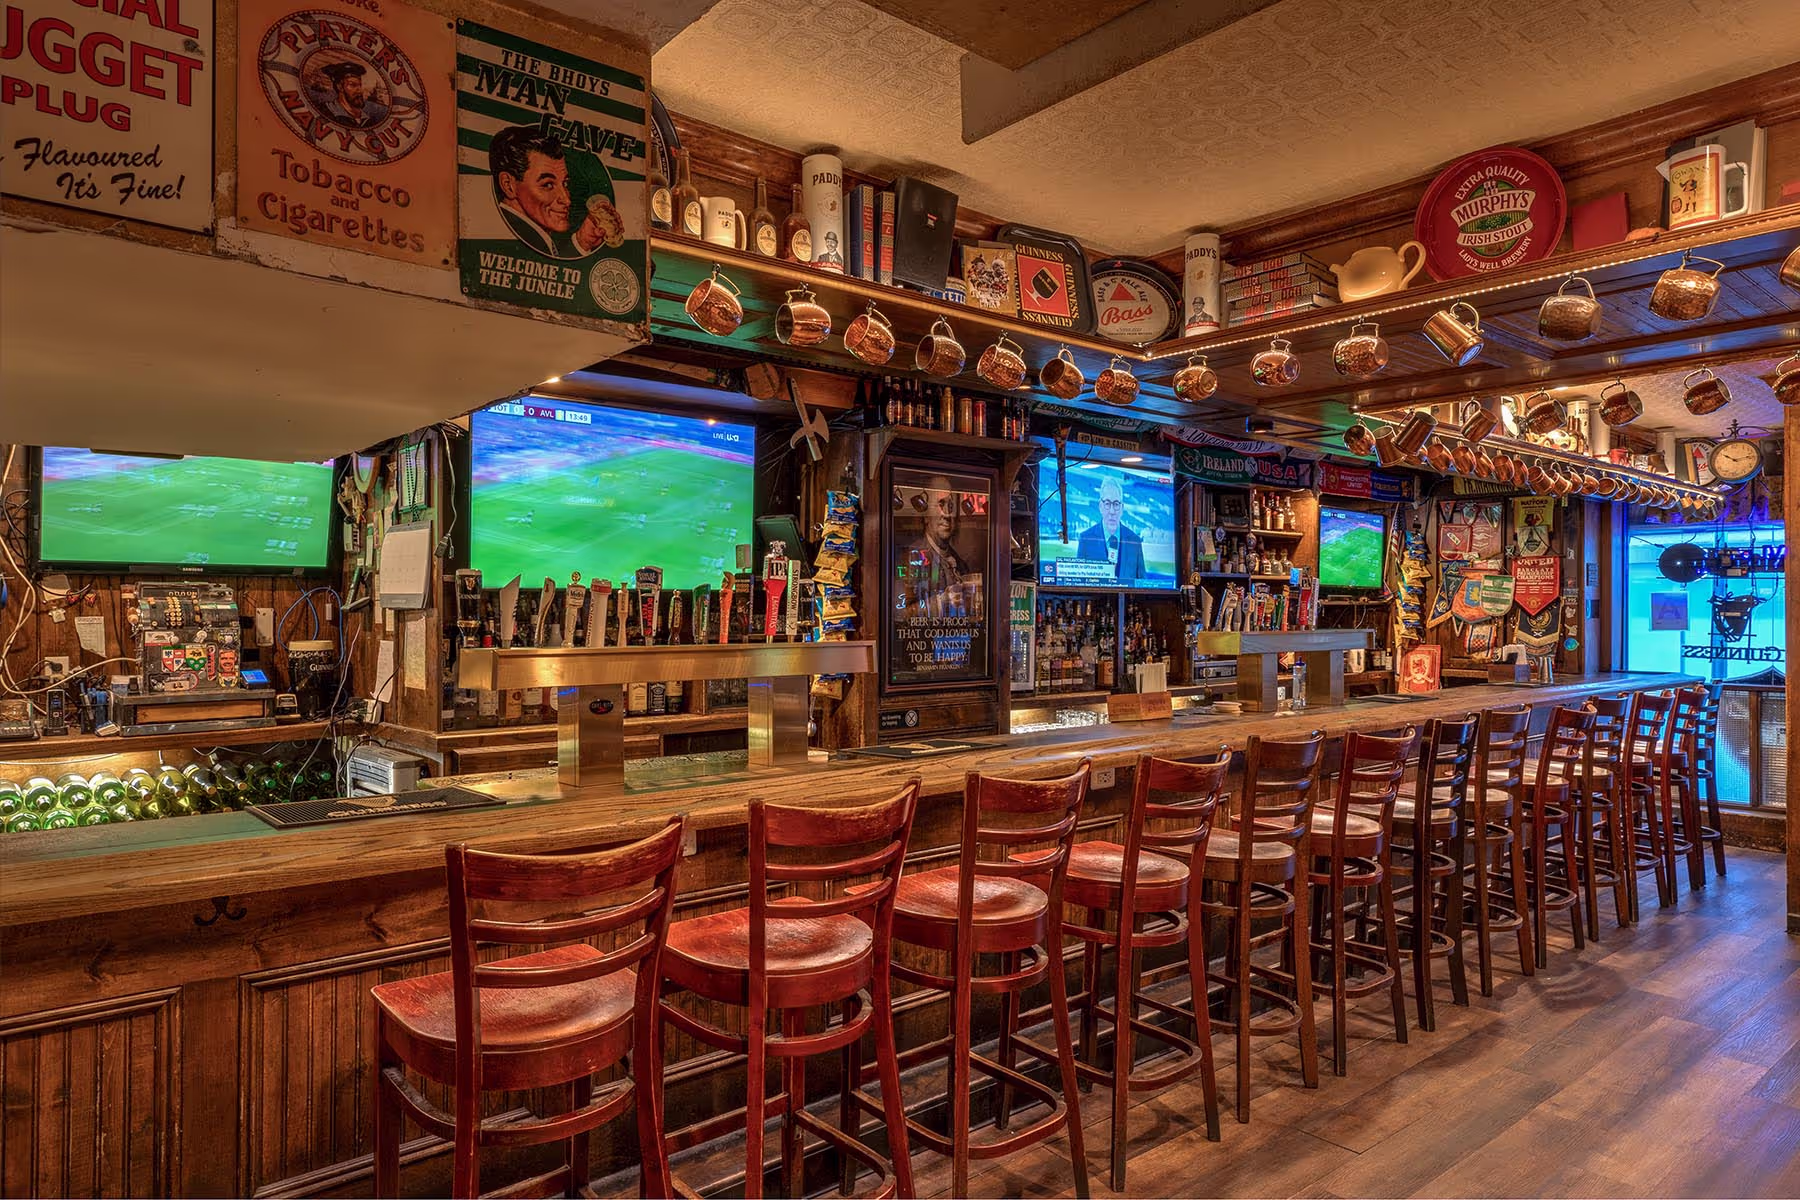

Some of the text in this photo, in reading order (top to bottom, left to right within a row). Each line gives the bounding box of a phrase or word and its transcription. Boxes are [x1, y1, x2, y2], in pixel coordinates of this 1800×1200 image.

[278, 19, 411, 85] PLAYER'S
[474, 62, 571, 115] MAN
[502, 49, 610, 96] THE BHOYS
[1, 75, 131, 132] PLUG
[279, 90, 413, 154] NAVY CUT
[540, 113, 636, 161] CAVE
[14, 137, 164, 171] Flavoured
[56, 172, 186, 206] It's Fine!
[271, 148, 411, 208] Tobacco
[1454, 165, 1530, 200] EXTRA QUALITY
[330, 195, 360, 211] and
[1455, 190, 1530, 223] MURPHY'S
[257, 191, 425, 252] Cigarettes
[1462, 221, 1528, 245] IRISH STOUT
[479, 251, 581, 285] WELCOME TO
[1015, 243, 1064, 262] GUINNESS
[1458, 249, 1478, 267] LADY'S
[1479, 261, 1500, 270] WELL
[1502, 235, 1532, 266] BREWERY
[479, 268, 513, 288] THE
[516, 276, 576, 300] JUNGLE
[1064, 263, 1079, 319] GUINNESS
[1120, 277, 1141, 290] PALE
[1022, 311, 1073, 327] GUINNESS
[1101, 304, 1153, 326] Bass
[528, 408, 535, 416] 0
[540, 409, 554, 418] AVL
[569, 413, 588, 421] 13:49
[1203, 454, 1244, 472] IRELAND
[1258, 459, 1298, 480] USA
[791, 569, 799, 611] STRONGBOW
[770, 595, 780, 629] LAGUNITAS
[910, 616, 969, 626] BEER IS PROOF
[896, 628, 980, 639] THAT GOD LOVES US
[906, 640, 971, 651] AND WANTS US
[909, 653, 922, 663] TO
[924, 653, 934, 662] BE
